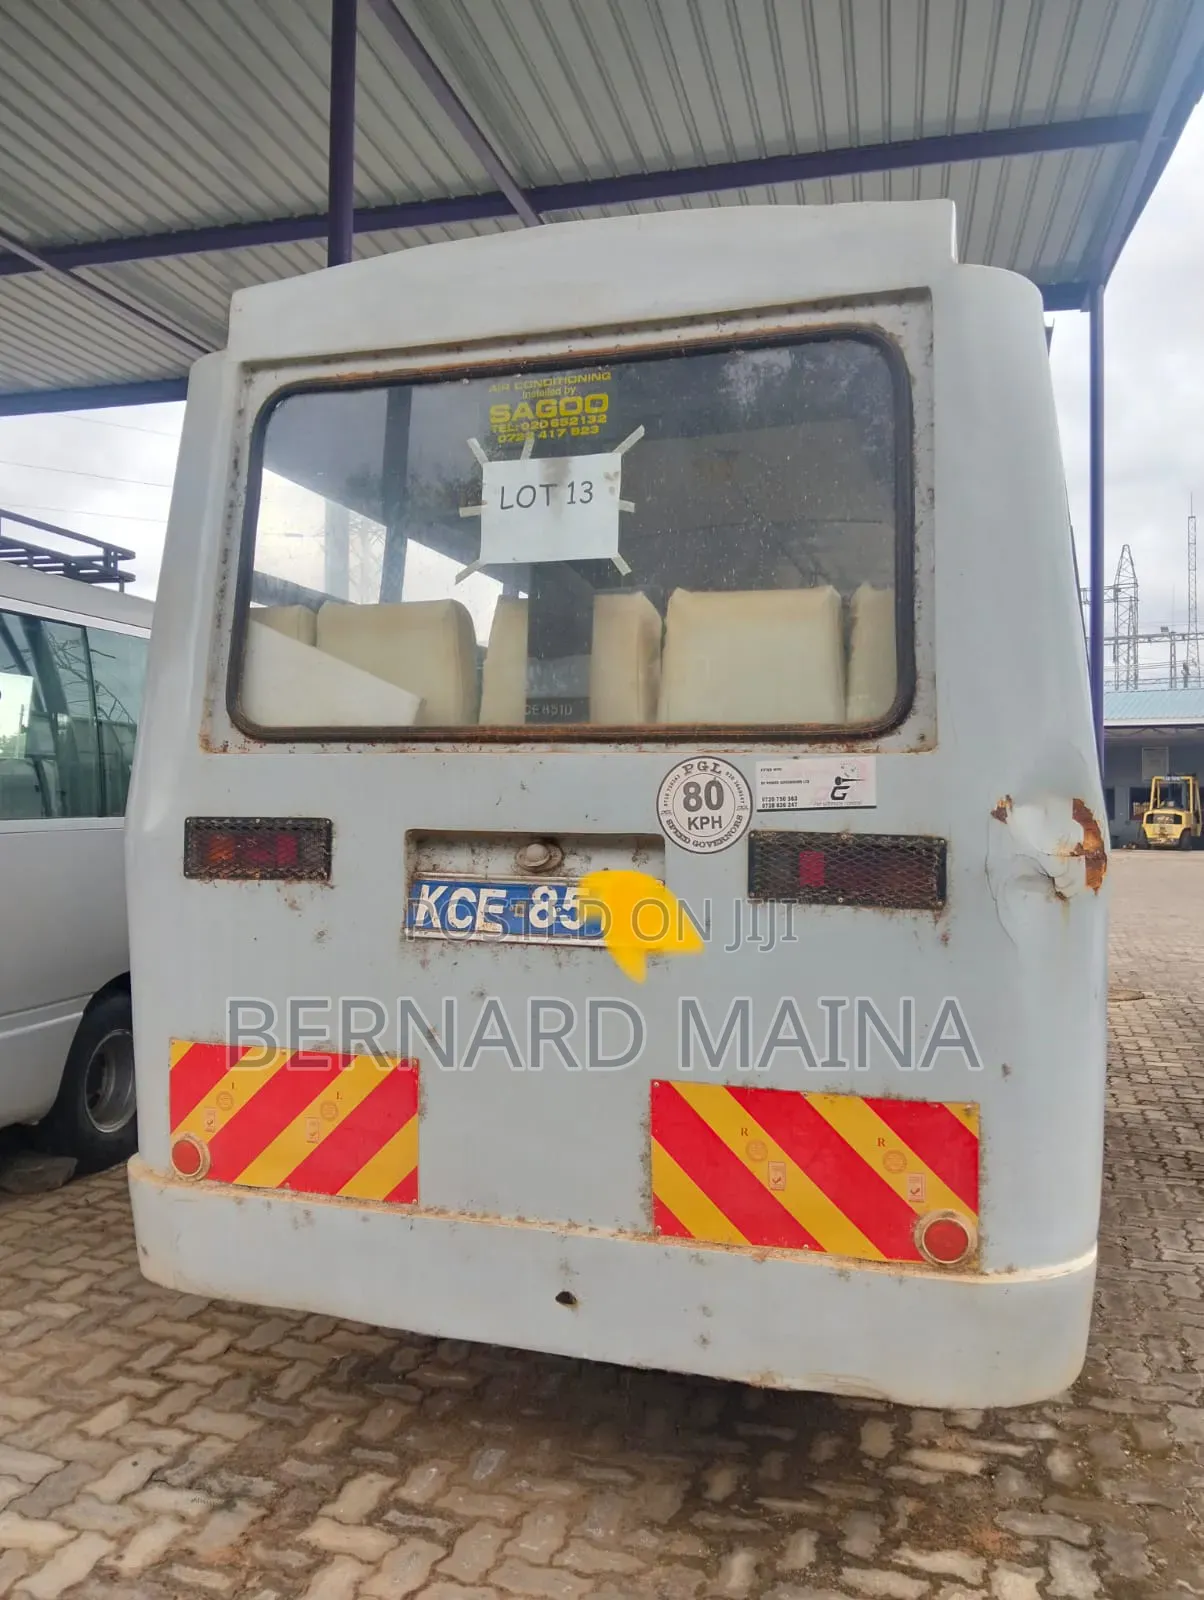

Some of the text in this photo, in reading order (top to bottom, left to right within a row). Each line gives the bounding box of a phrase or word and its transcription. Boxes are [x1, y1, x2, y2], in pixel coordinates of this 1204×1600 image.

[488, 371, 612, 393] AIR CONDITIONING
[564, 386, 577, 396] by
[489, 393, 609, 424] SAGOO
[538, 427, 567, 440] 417
[500, 480, 594, 510] LOT 13
[681, 760, 722, 776] PGL
[682, 779, 724, 812] 80
[687, 815, 723, 831] KPH
[692, 814, 744, 849] GOVERNORS
[414, 884, 592, 933] KCE 85
[740, 1127, 749, 1137] R
[877, 1137, 886, 1147] R
